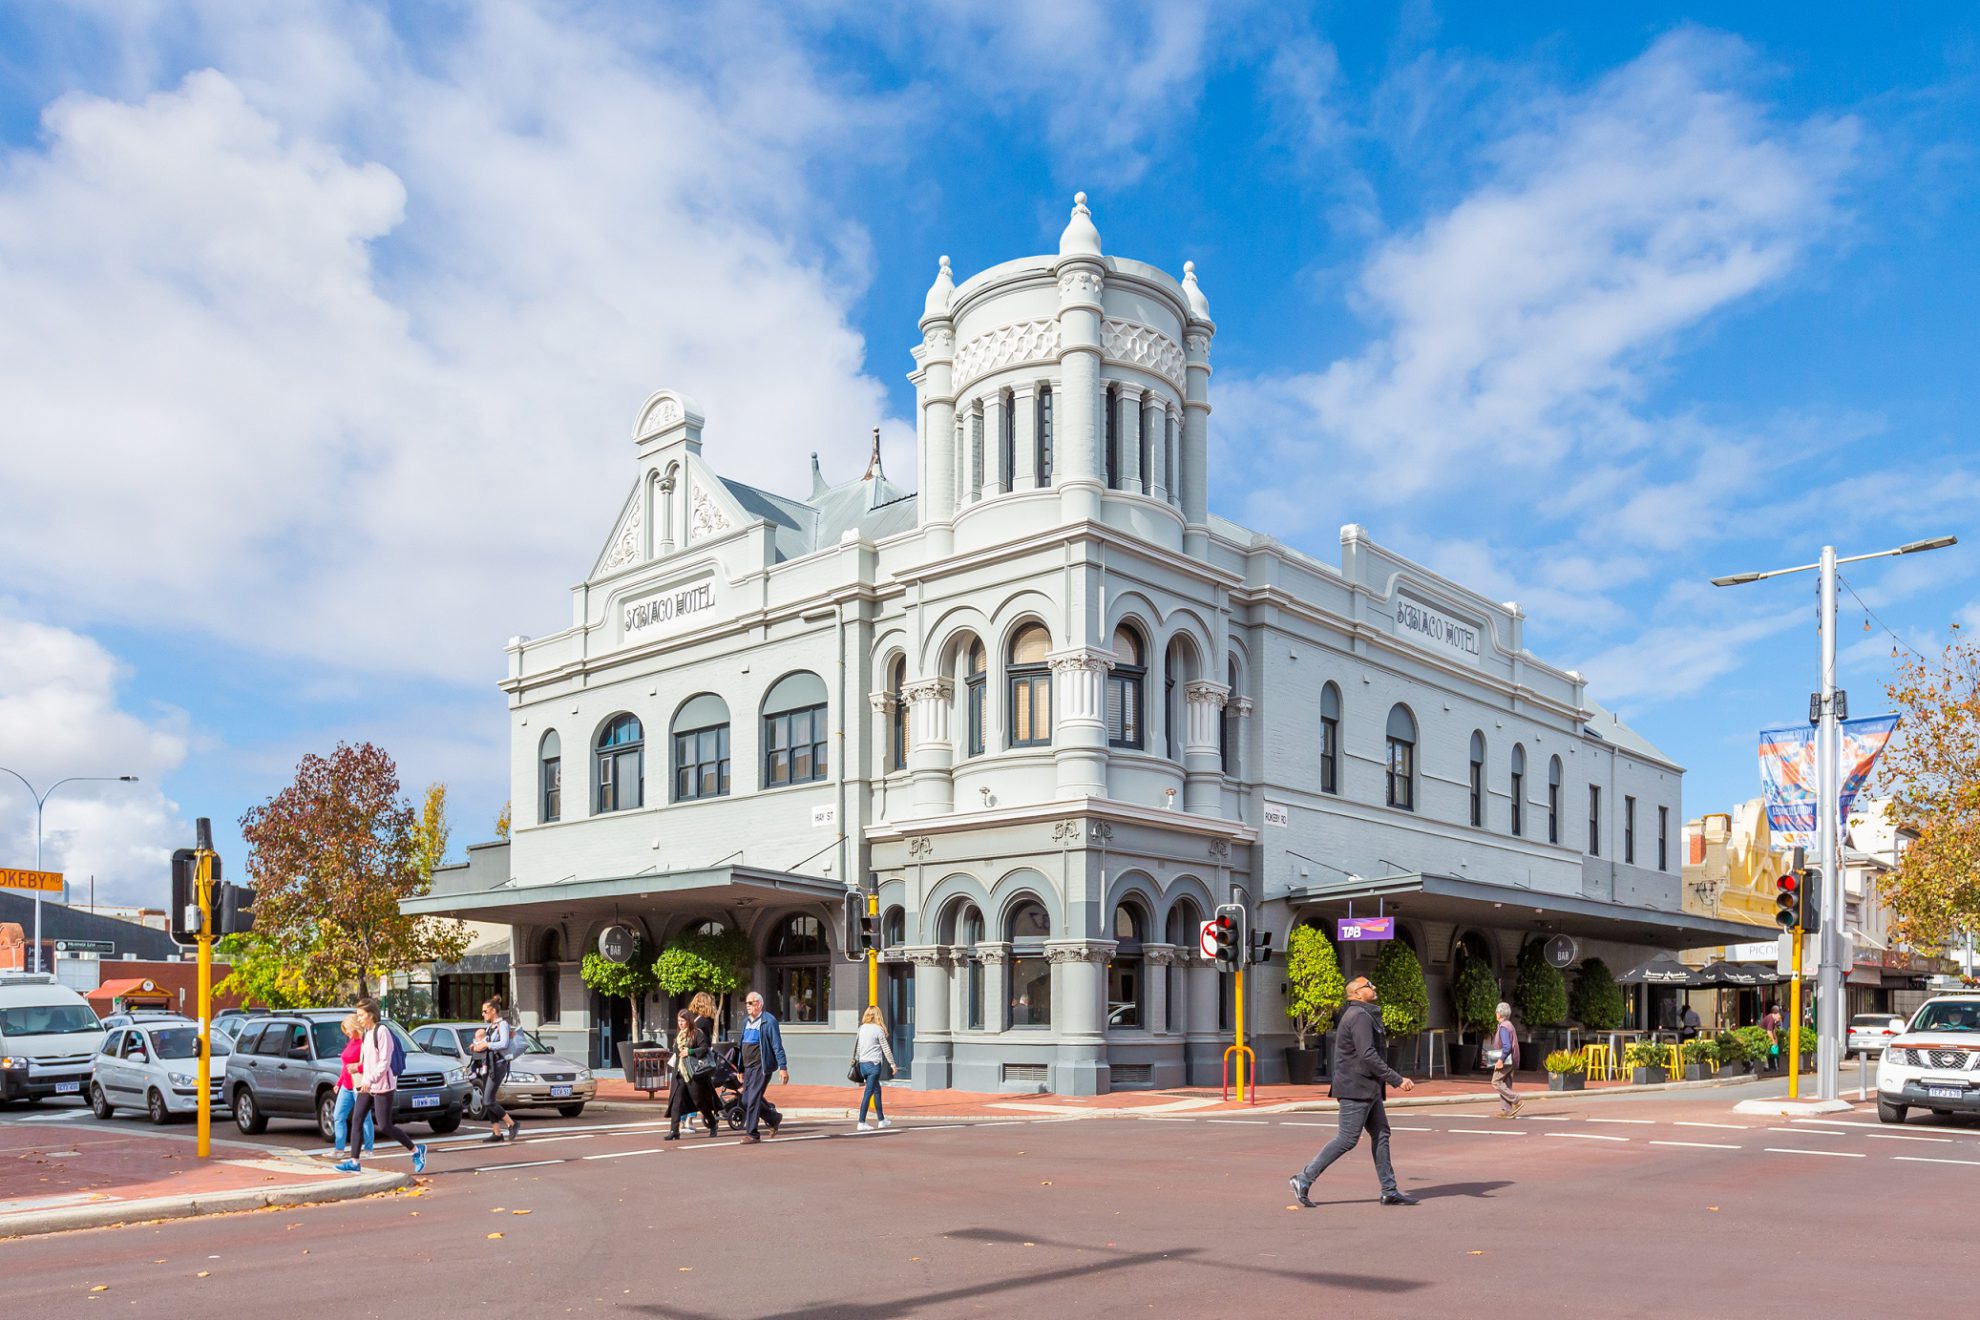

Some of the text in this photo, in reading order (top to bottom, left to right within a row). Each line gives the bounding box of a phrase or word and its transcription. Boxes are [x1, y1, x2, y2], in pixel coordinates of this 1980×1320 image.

[625, 582, 716, 631] SUBIACO HOTEL
[1397, 601, 1479, 656] SUBIACO HOTEL
[815, 811, 834, 821] HAY ST
[1341, 926, 1361, 939] TAB
[610, 944, 622, 956] BAR
[1557, 951, 1570, 961] BAR
